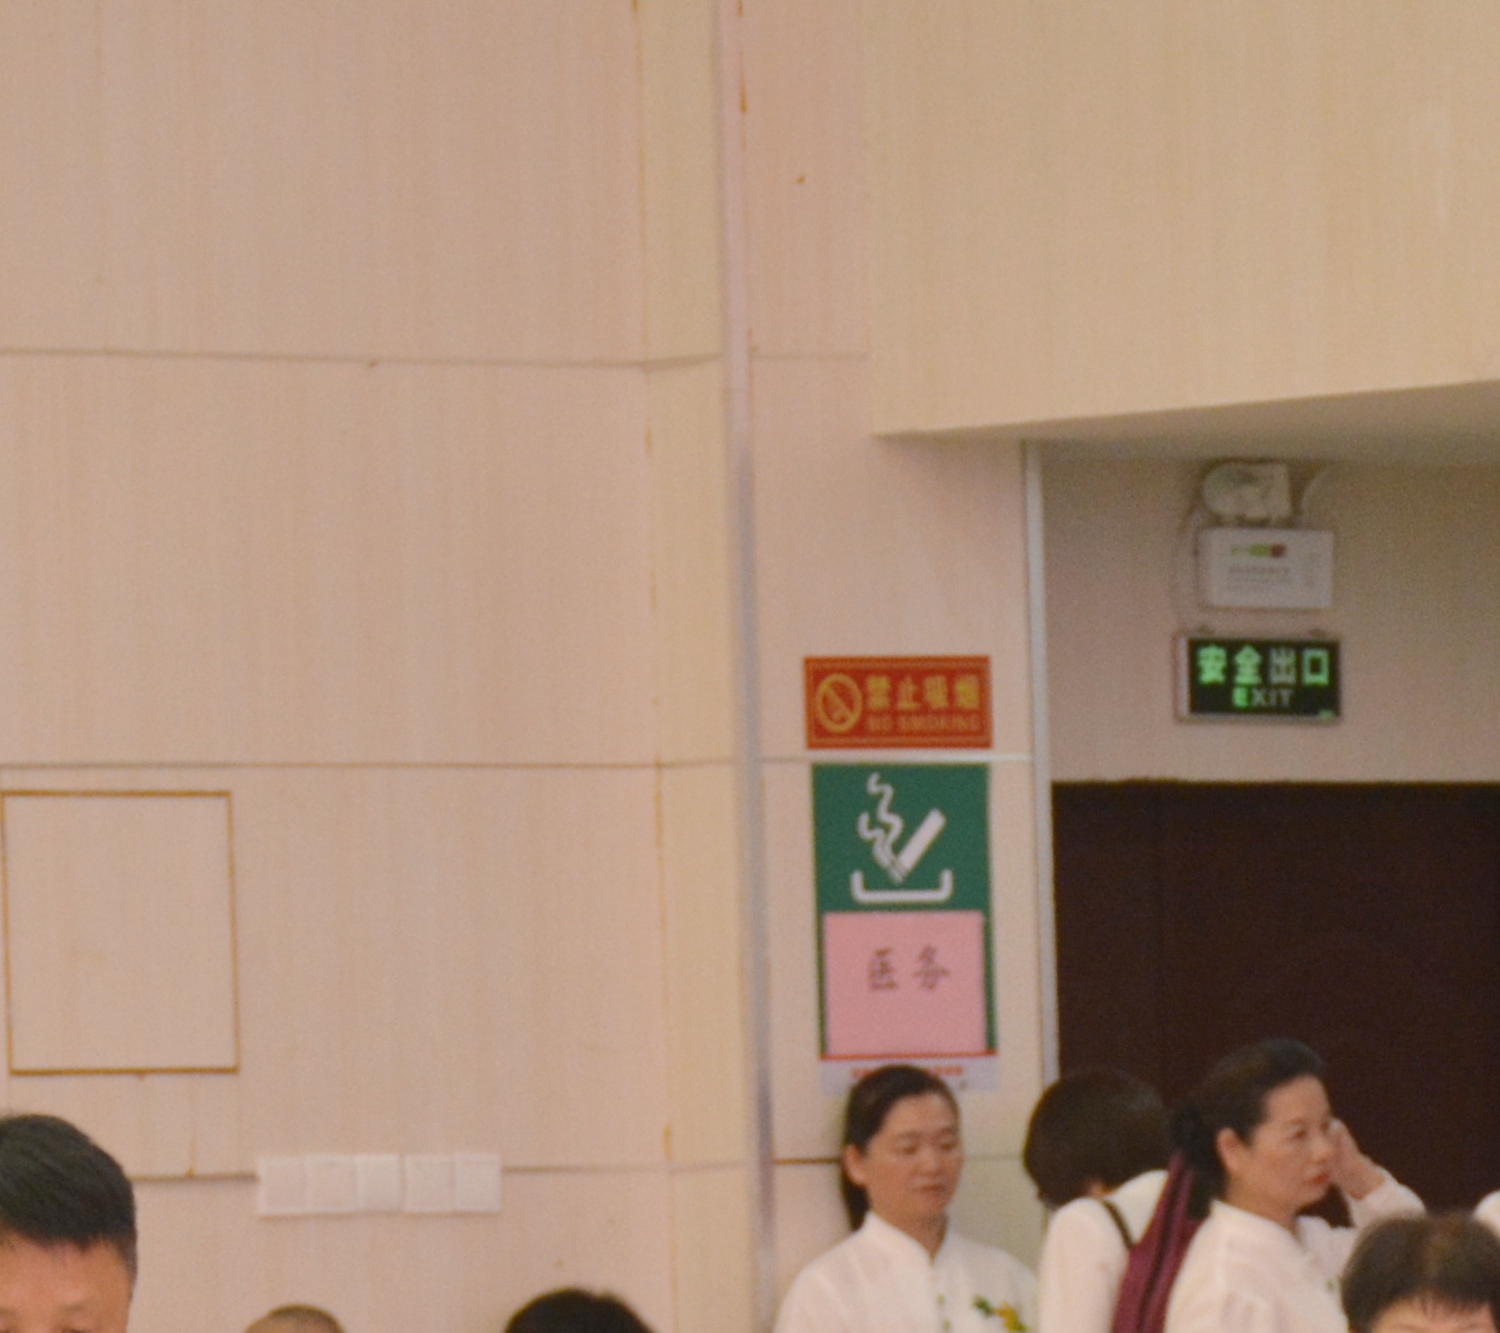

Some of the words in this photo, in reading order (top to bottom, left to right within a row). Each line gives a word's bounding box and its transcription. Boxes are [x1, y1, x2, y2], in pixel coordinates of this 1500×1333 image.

[1197, 644, 1329, 684] 安全出口
[866, 674, 981, 712] 禁止吸烟
[1232, 685, 1293, 709] EXIT
[869, 946, 950, 991] 医务
